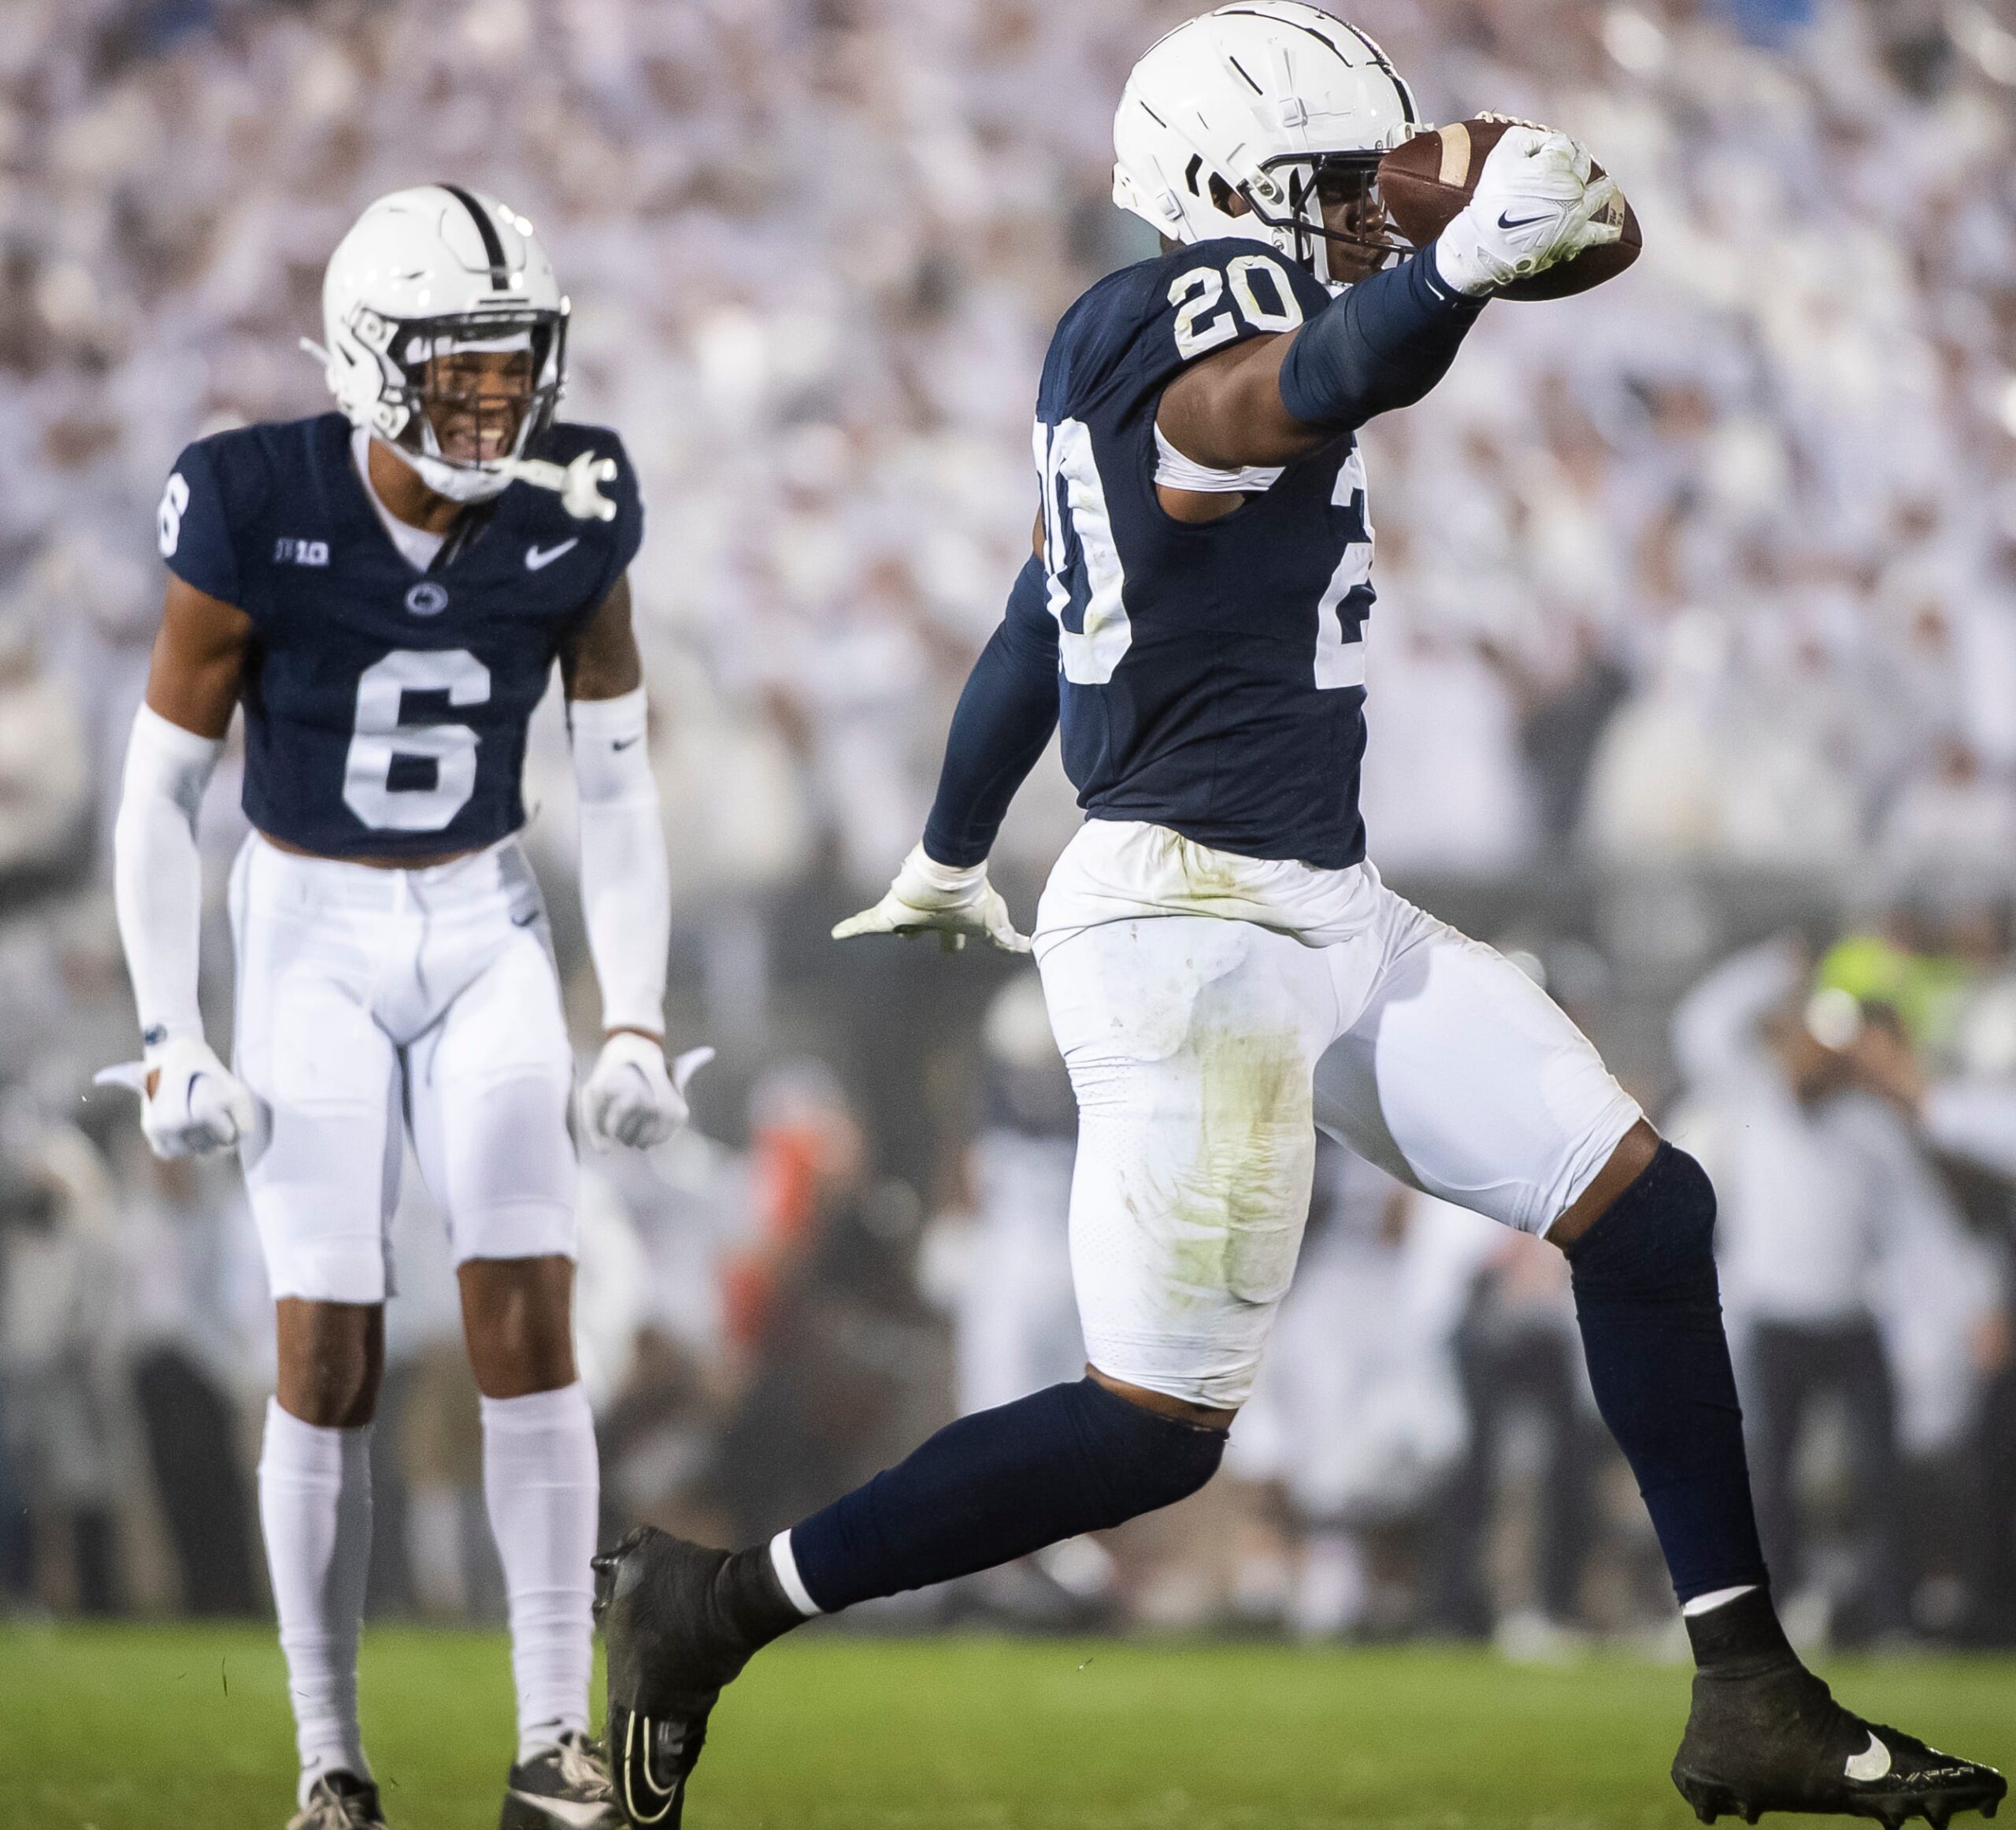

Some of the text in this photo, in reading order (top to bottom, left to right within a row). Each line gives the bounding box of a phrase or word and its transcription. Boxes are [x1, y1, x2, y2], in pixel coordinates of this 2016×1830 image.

[1167, 255, 1303, 360] 20
[159, 472, 190, 558] 6
[343, 649, 490, 831] 6
